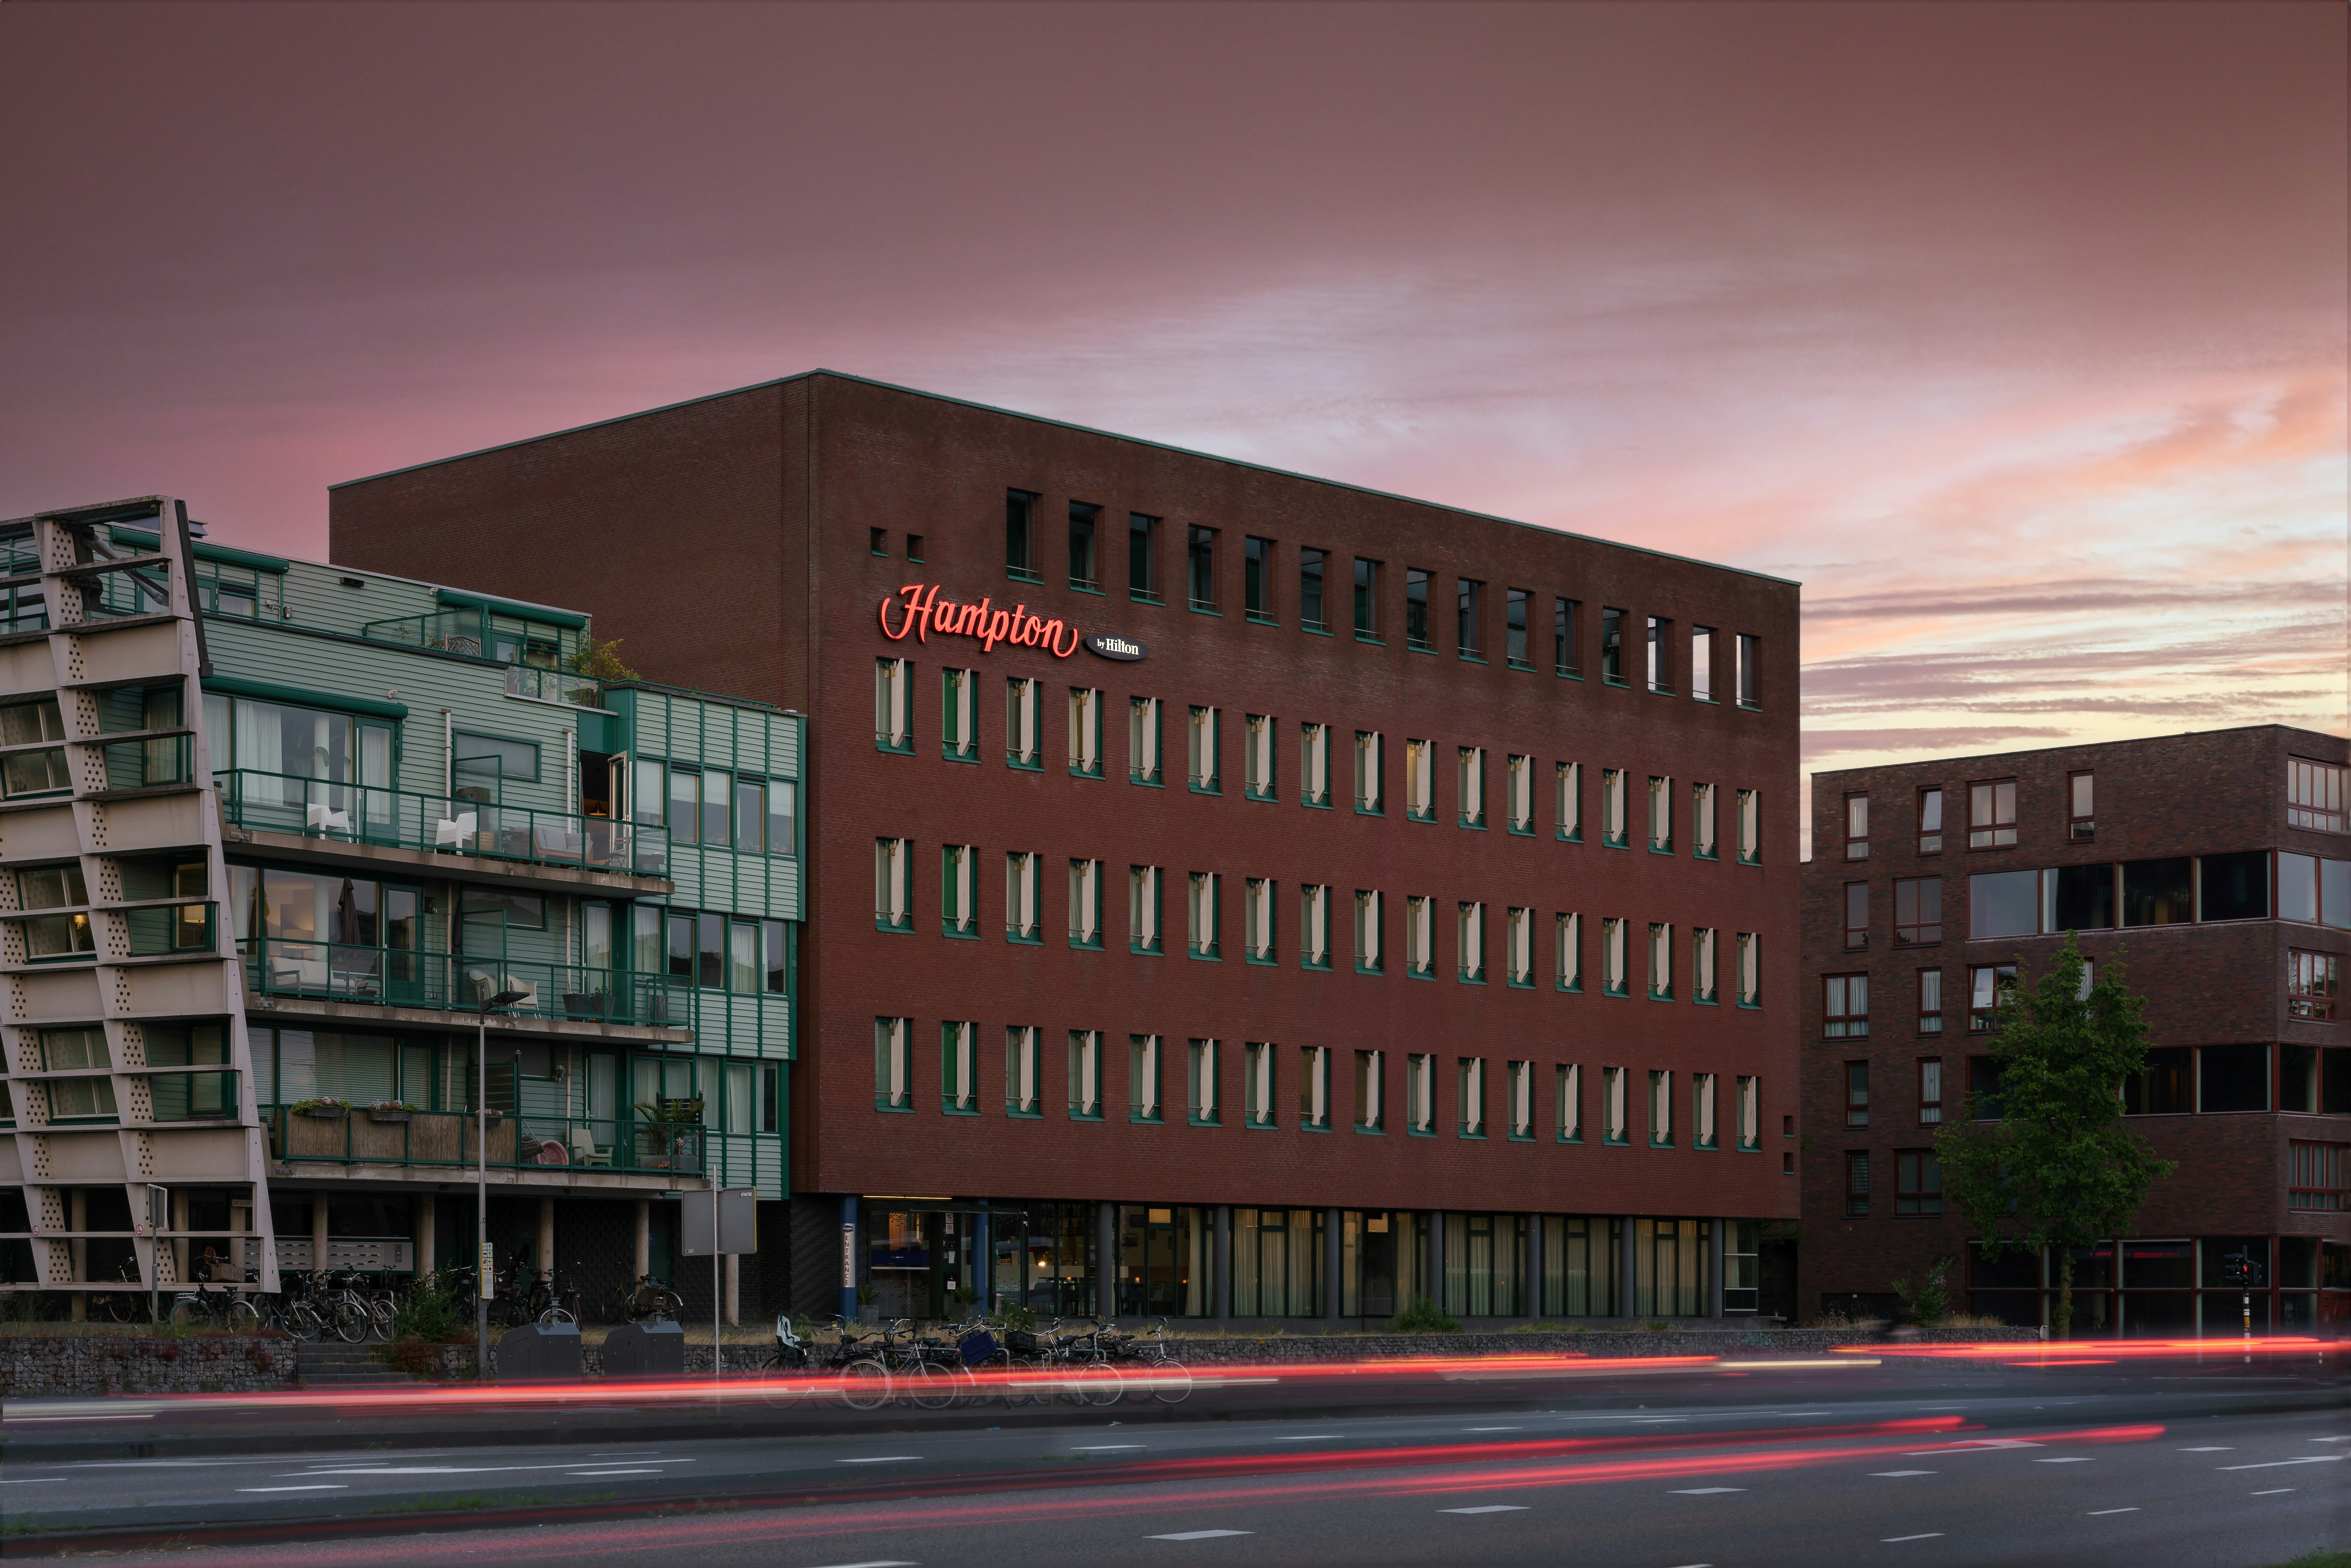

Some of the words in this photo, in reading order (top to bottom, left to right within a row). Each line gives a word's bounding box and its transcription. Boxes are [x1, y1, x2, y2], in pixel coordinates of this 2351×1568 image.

[880, 584, 1078, 658] Hampton
[1097, 639, 1105, 649] by
[1106, 638, 1139, 655] Hilton
